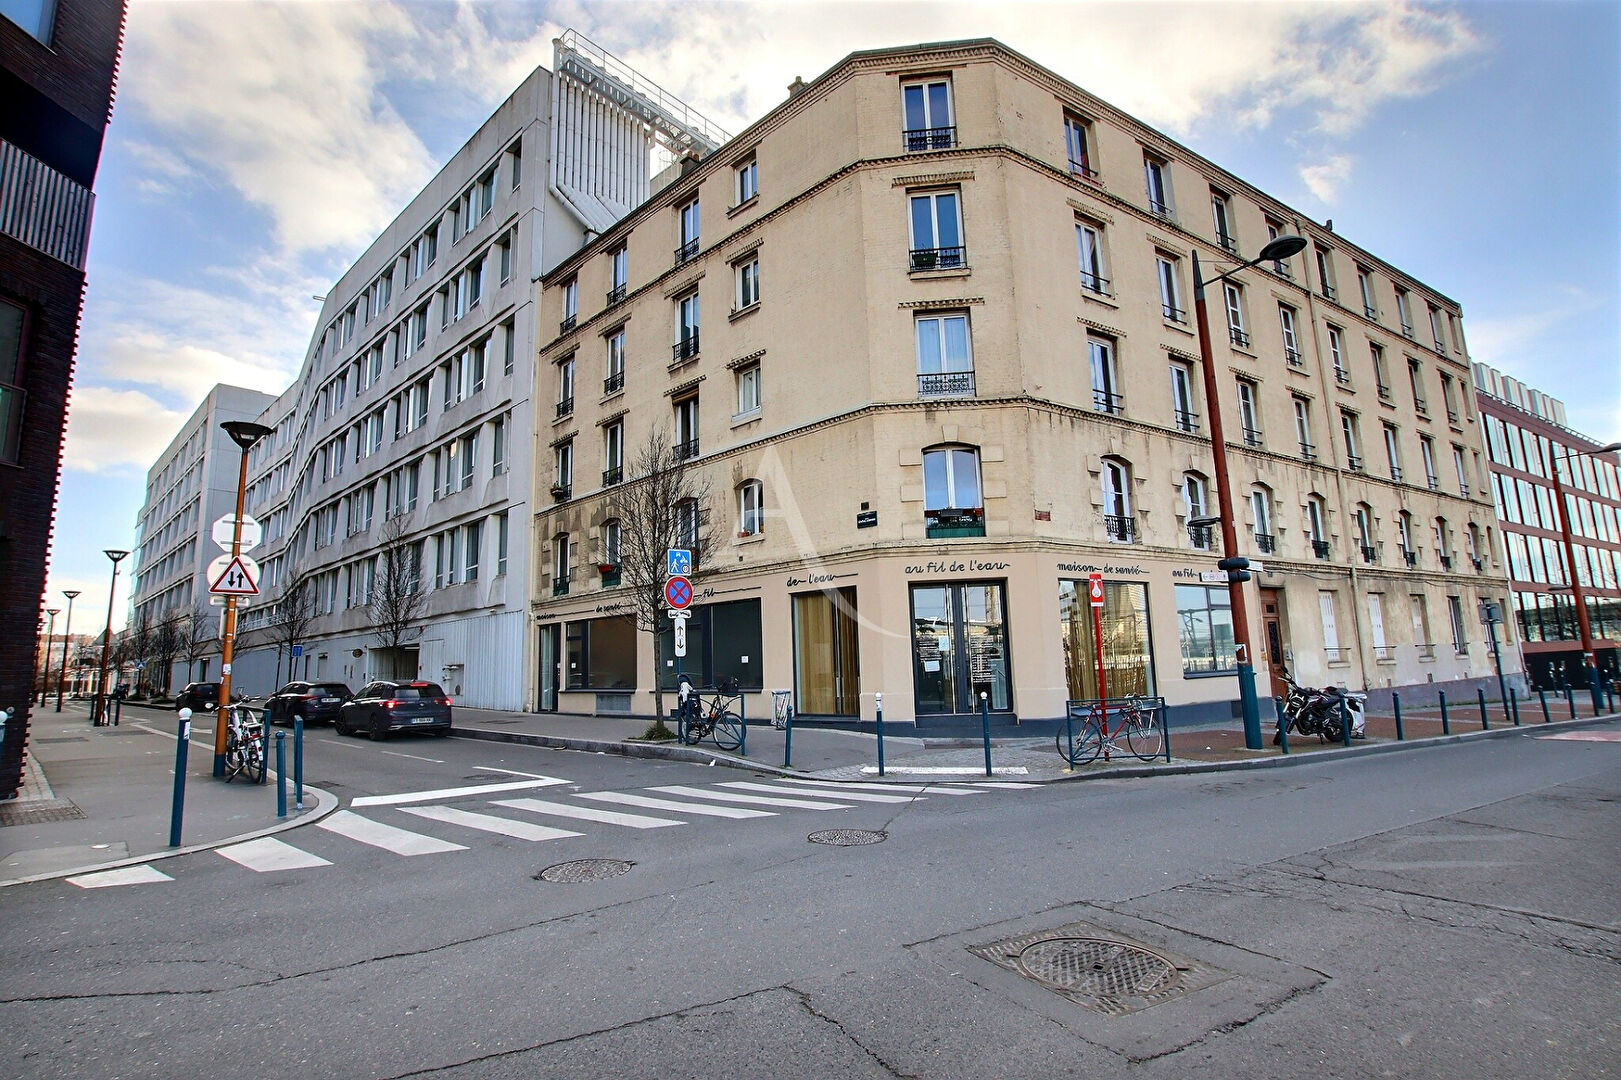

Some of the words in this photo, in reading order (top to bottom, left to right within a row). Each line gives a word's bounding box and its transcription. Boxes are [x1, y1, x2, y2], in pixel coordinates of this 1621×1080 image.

[904, 565, 925, 574] au
[926, 561, 947, 573] fil
[949, 560, 966, 572] de
[969, 559, 1011, 571] l'eau
[1056, 561, 1102, 572] maison
[1103, 563, 1114, 574] de
[1115, 564, 1147, 576] santé
[786, 576, 803, 588] de
[808, 572, 841, 584] l'eau
